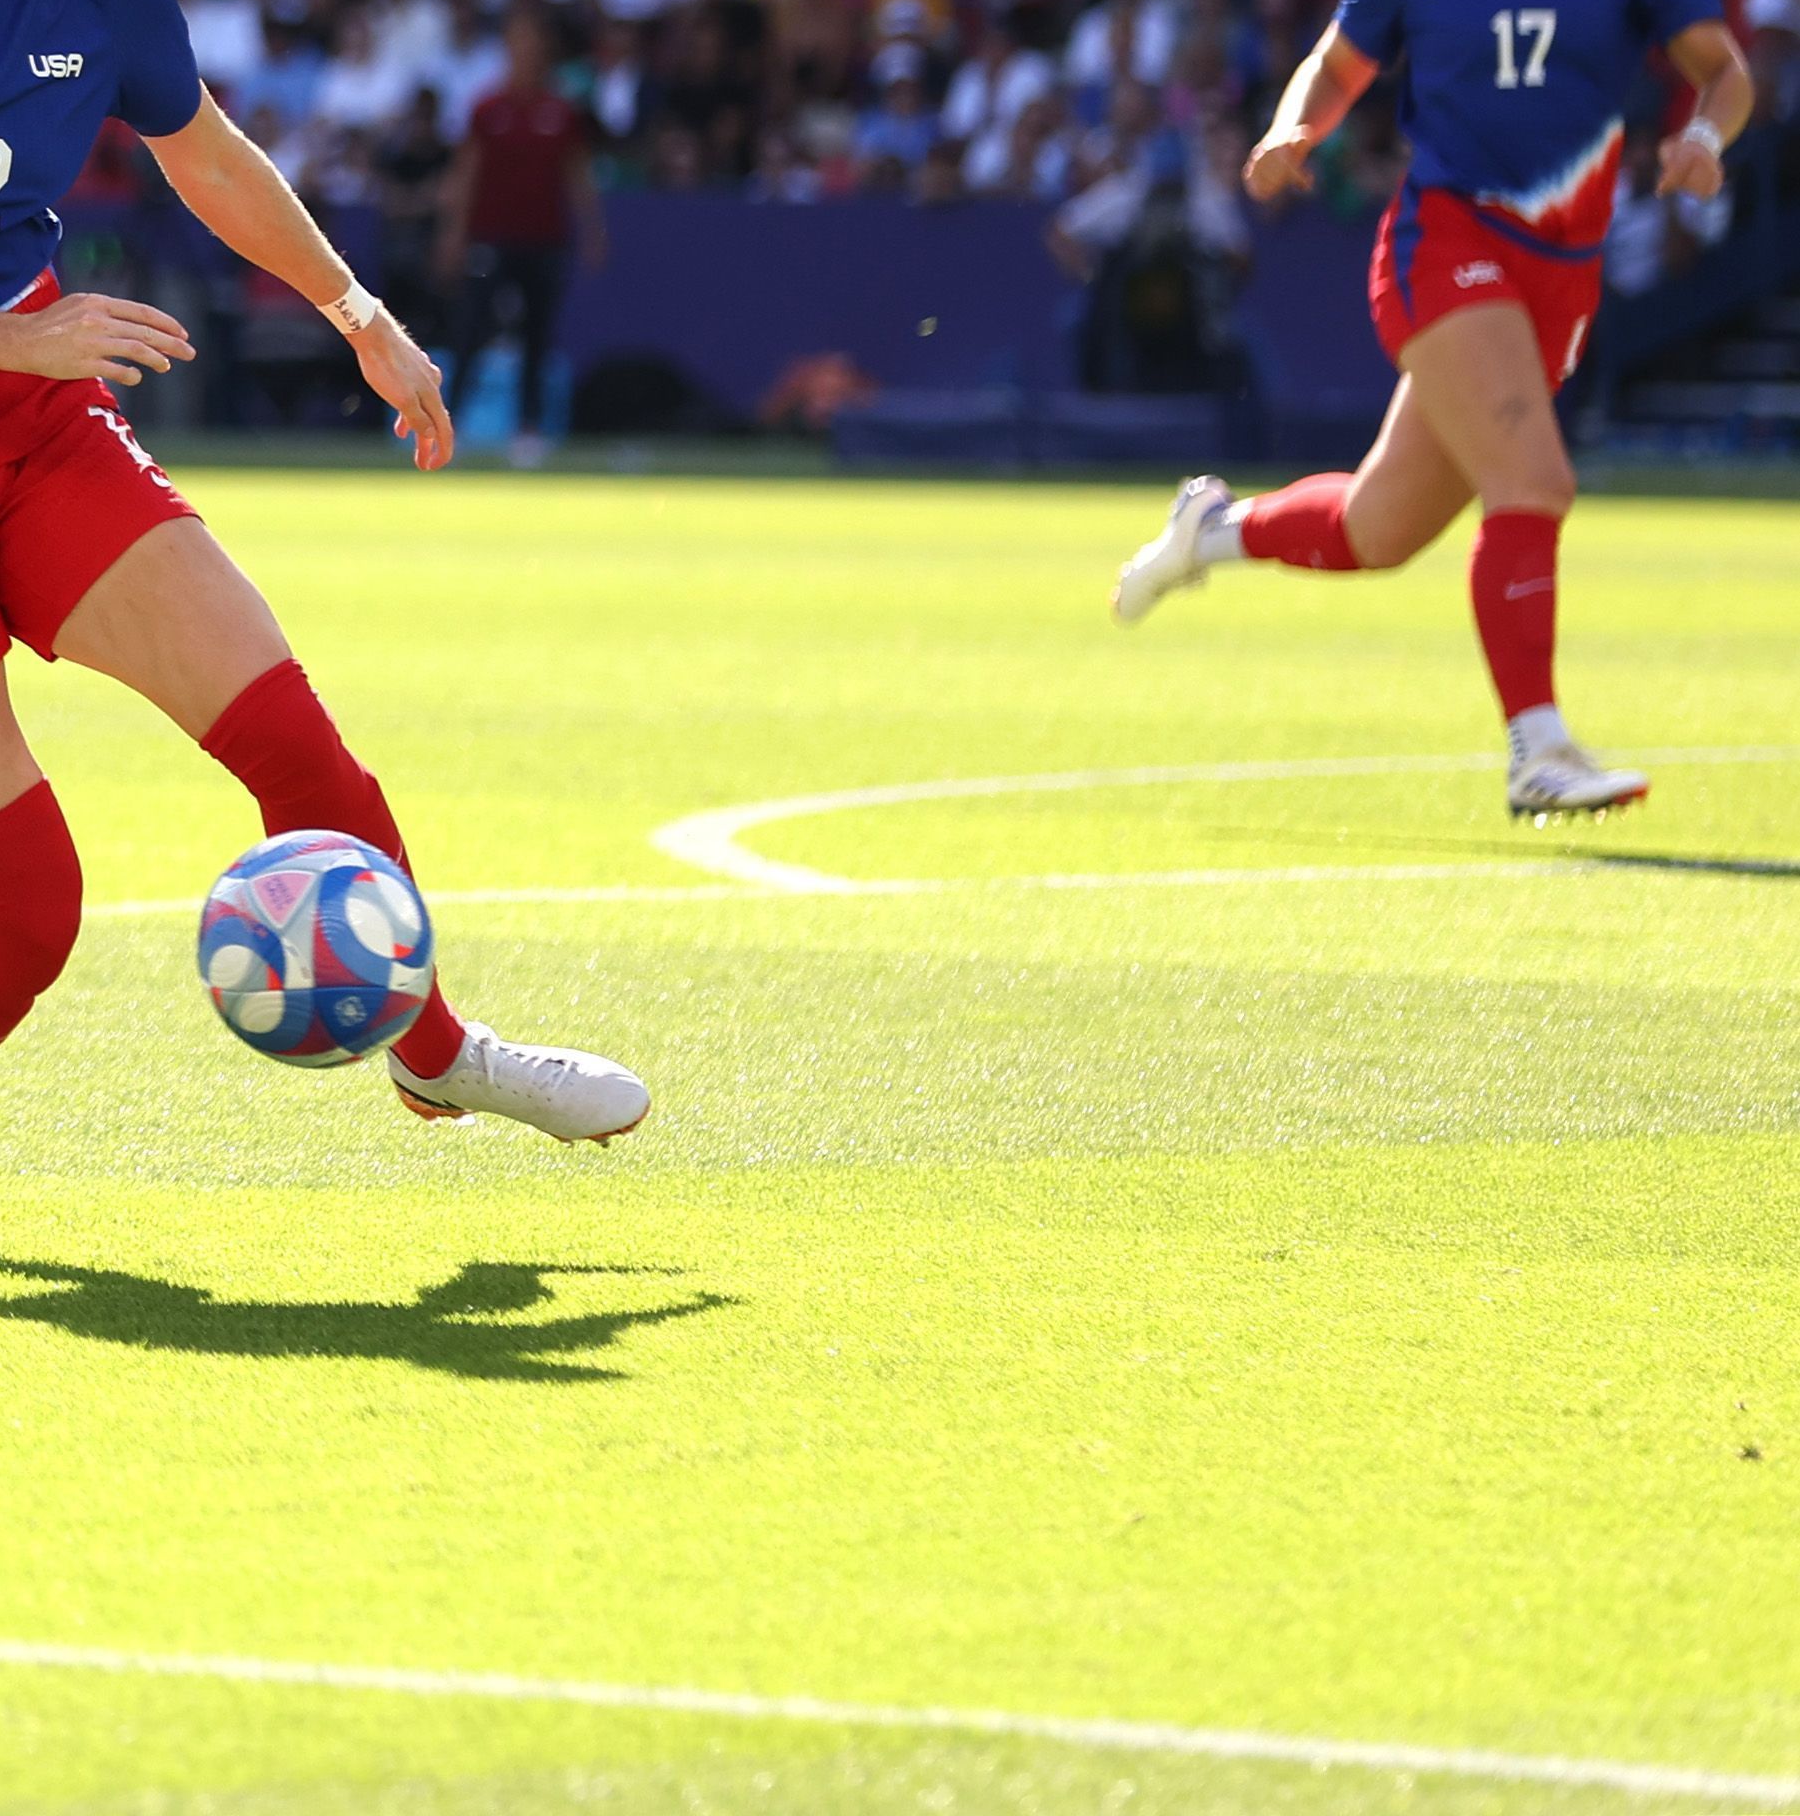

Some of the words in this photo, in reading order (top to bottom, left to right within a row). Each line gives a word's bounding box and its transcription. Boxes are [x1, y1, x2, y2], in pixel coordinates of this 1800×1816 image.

[1489, 7, 1557, 90] 17
[28, 53, 84, 78] USA
[1452, 260, 1505, 289] USA
